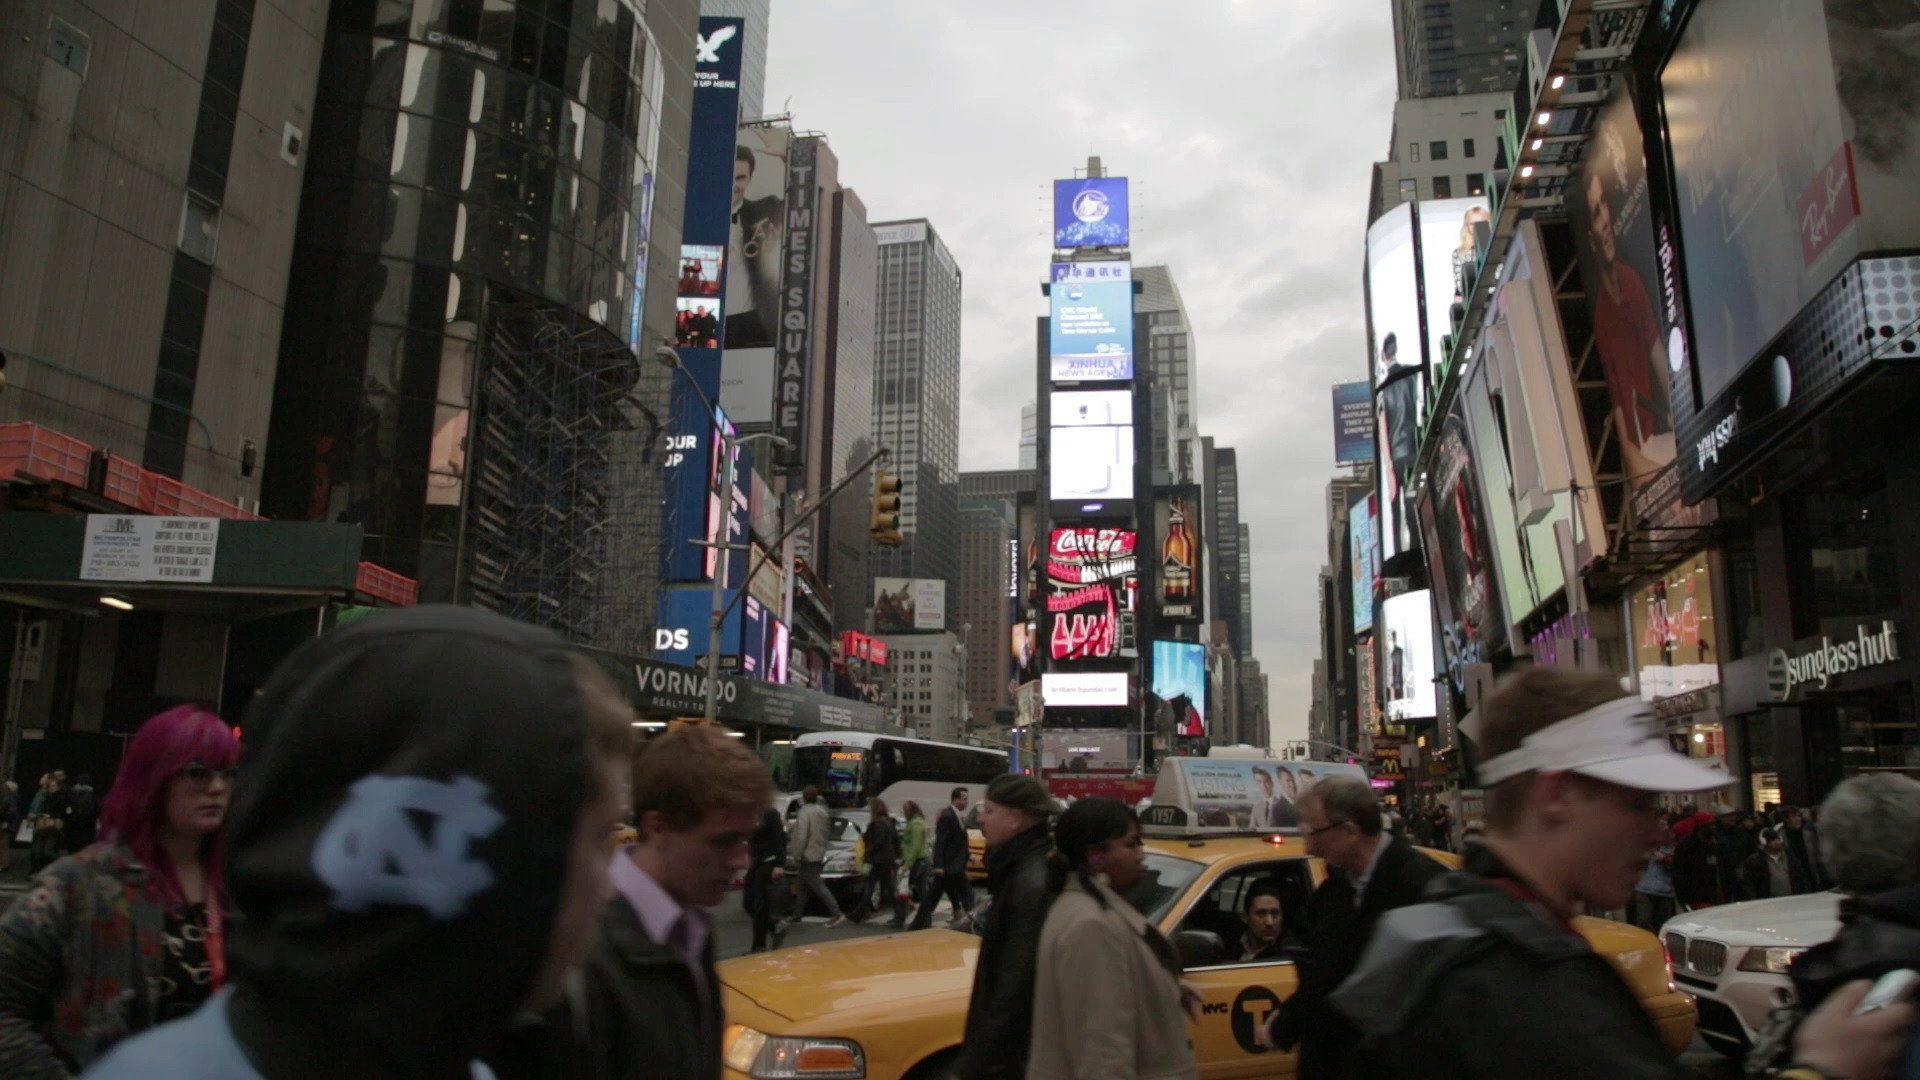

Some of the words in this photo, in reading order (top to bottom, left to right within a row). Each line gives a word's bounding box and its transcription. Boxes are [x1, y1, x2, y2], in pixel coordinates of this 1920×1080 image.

[694, 72, 719, 80] YOUR
[713, 80, 736, 88] HERE
[790, 165, 813, 275] TIMES
[782, 286, 806, 428] SQUARE
[655, 628, 689, 650] DS
[1789, 635, 1858, 690] sunglass
[1857, 620, 1896, 667] hut
[635, 664, 736, 703] VORNADO
[652, 697, 689, 709] REALTY
[1202, 1002, 1228, 1016] NYC
